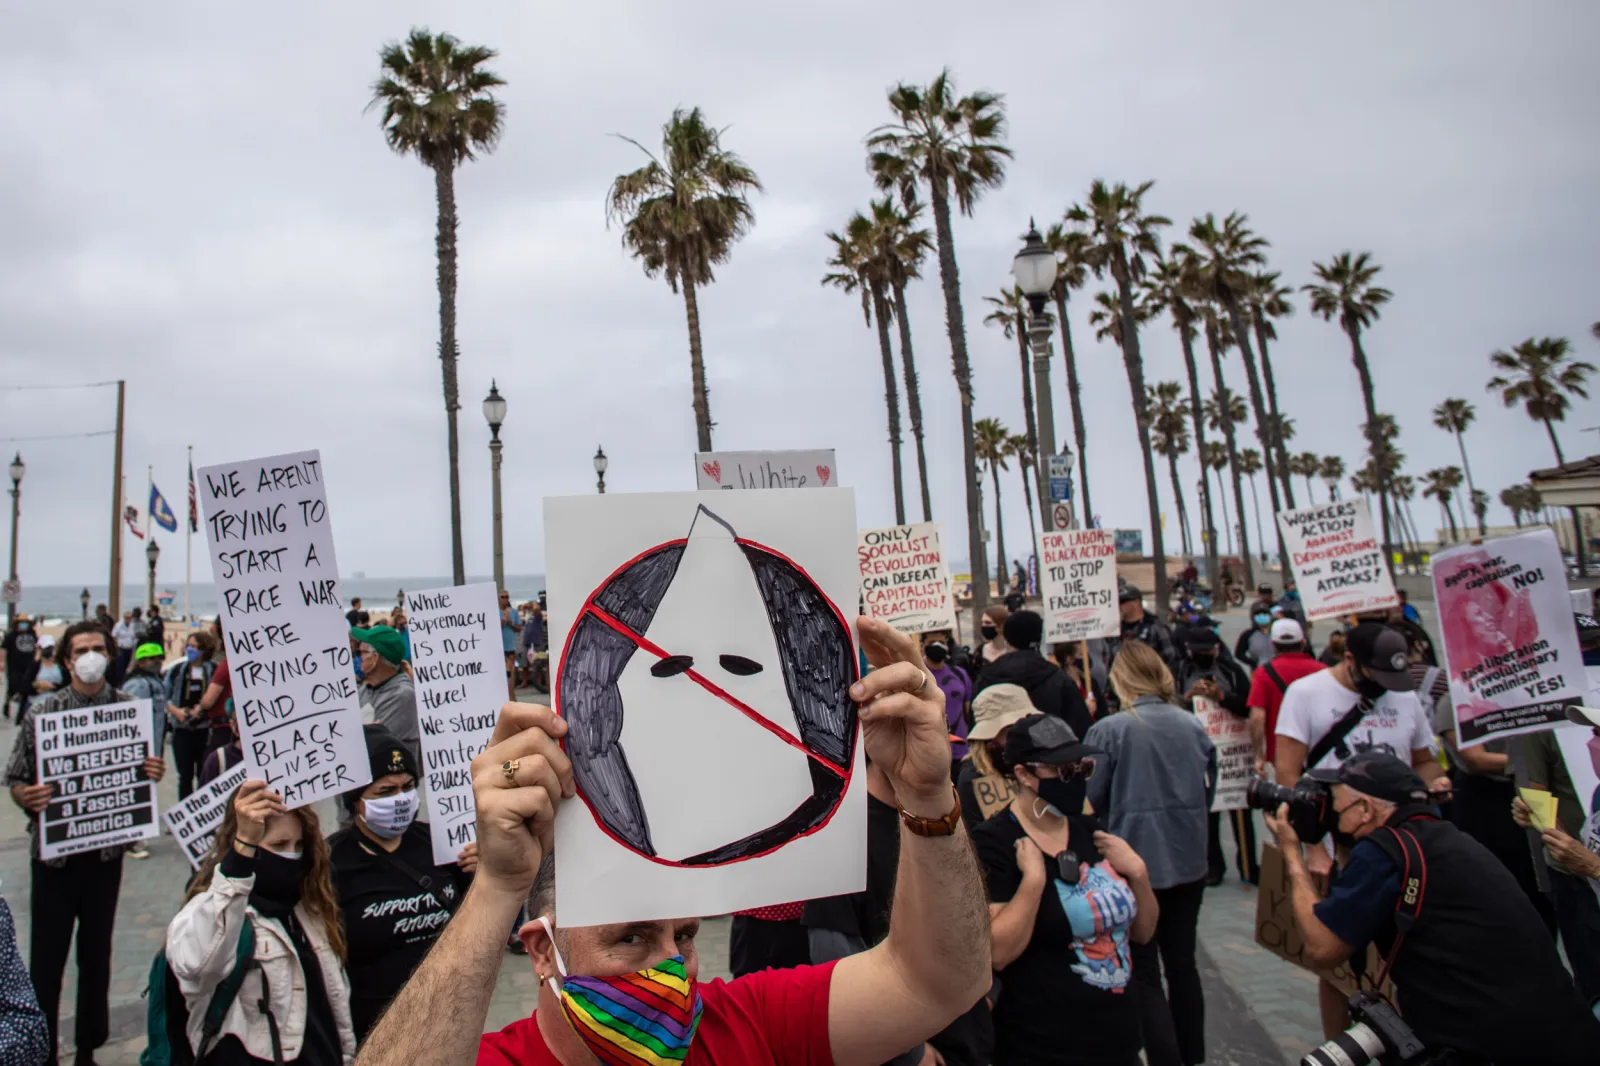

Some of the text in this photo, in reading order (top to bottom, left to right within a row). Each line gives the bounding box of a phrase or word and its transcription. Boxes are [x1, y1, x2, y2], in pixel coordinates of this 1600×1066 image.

[206, 470, 246, 499] WE
[209, 499, 326, 542] TRYING TO
[1301, 518, 1354, 538] ACTION
[857, 536, 929, 561] SOCIALIST
[865, 527, 912, 545] ONLY
[1042, 535, 1065, 550] FOR
[1305, 529, 1354, 549] AGAINST
[218, 542, 321, 579] START A
[858, 552, 940, 577] REVOLUTION
[1043, 544, 1116, 565] BLACK ACTION
[1330, 553, 1379, 574] RACIST
[863, 567, 937, 590] CAN DEFEAT
[1048, 566, 1065, 582] TO
[1070, 559, 1104, 579] STOP
[1465, 563, 1522, 590] capitalism
[1512, 568, 1544, 589] NO!
[866, 581, 943, 604] CAPITALIST
[1063, 579, 1085, 595] THE
[223, 584, 282, 617] RACE
[1049, 589, 1112, 611] FASCISTS!
[229, 622, 300, 654] WE'RE
[443, 633, 480, 653] not
[1484, 639, 1549, 669] liberation
[234, 646, 350, 689] TRYING TO
[1475, 649, 1559, 687] revolutionary
[1481, 670, 1540, 700] feminism
[1524, 674, 1566, 699] YES!
[242, 677, 356, 727] END ONE
[41, 707, 137, 732] In the Name
[421, 715, 444, 735] We
[42, 724, 141, 751] of Humanity,
[252, 720, 343, 767] BLACK
[47, 744, 144, 775] We REFUSE
[264, 743, 336, 785] LIVES
[58, 767, 138, 795] To Accept
[273, 764, 355, 804] ATTER
[428, 769, 472, 792] Black
[61, 788, 136, 817] a Fascist
[168, 768, 248, 825] In the Name
[437, 795, 472, 815] STIL
[65, 812, 133, 838] America
[179, 821, 195, 839] of
[447, 822, 477, 847] MAT
[1404, 877, 1420, 905] EOS
[361, 894, 424, 919] SUPPORT
[393, 909, 451, 934] FUTURES
